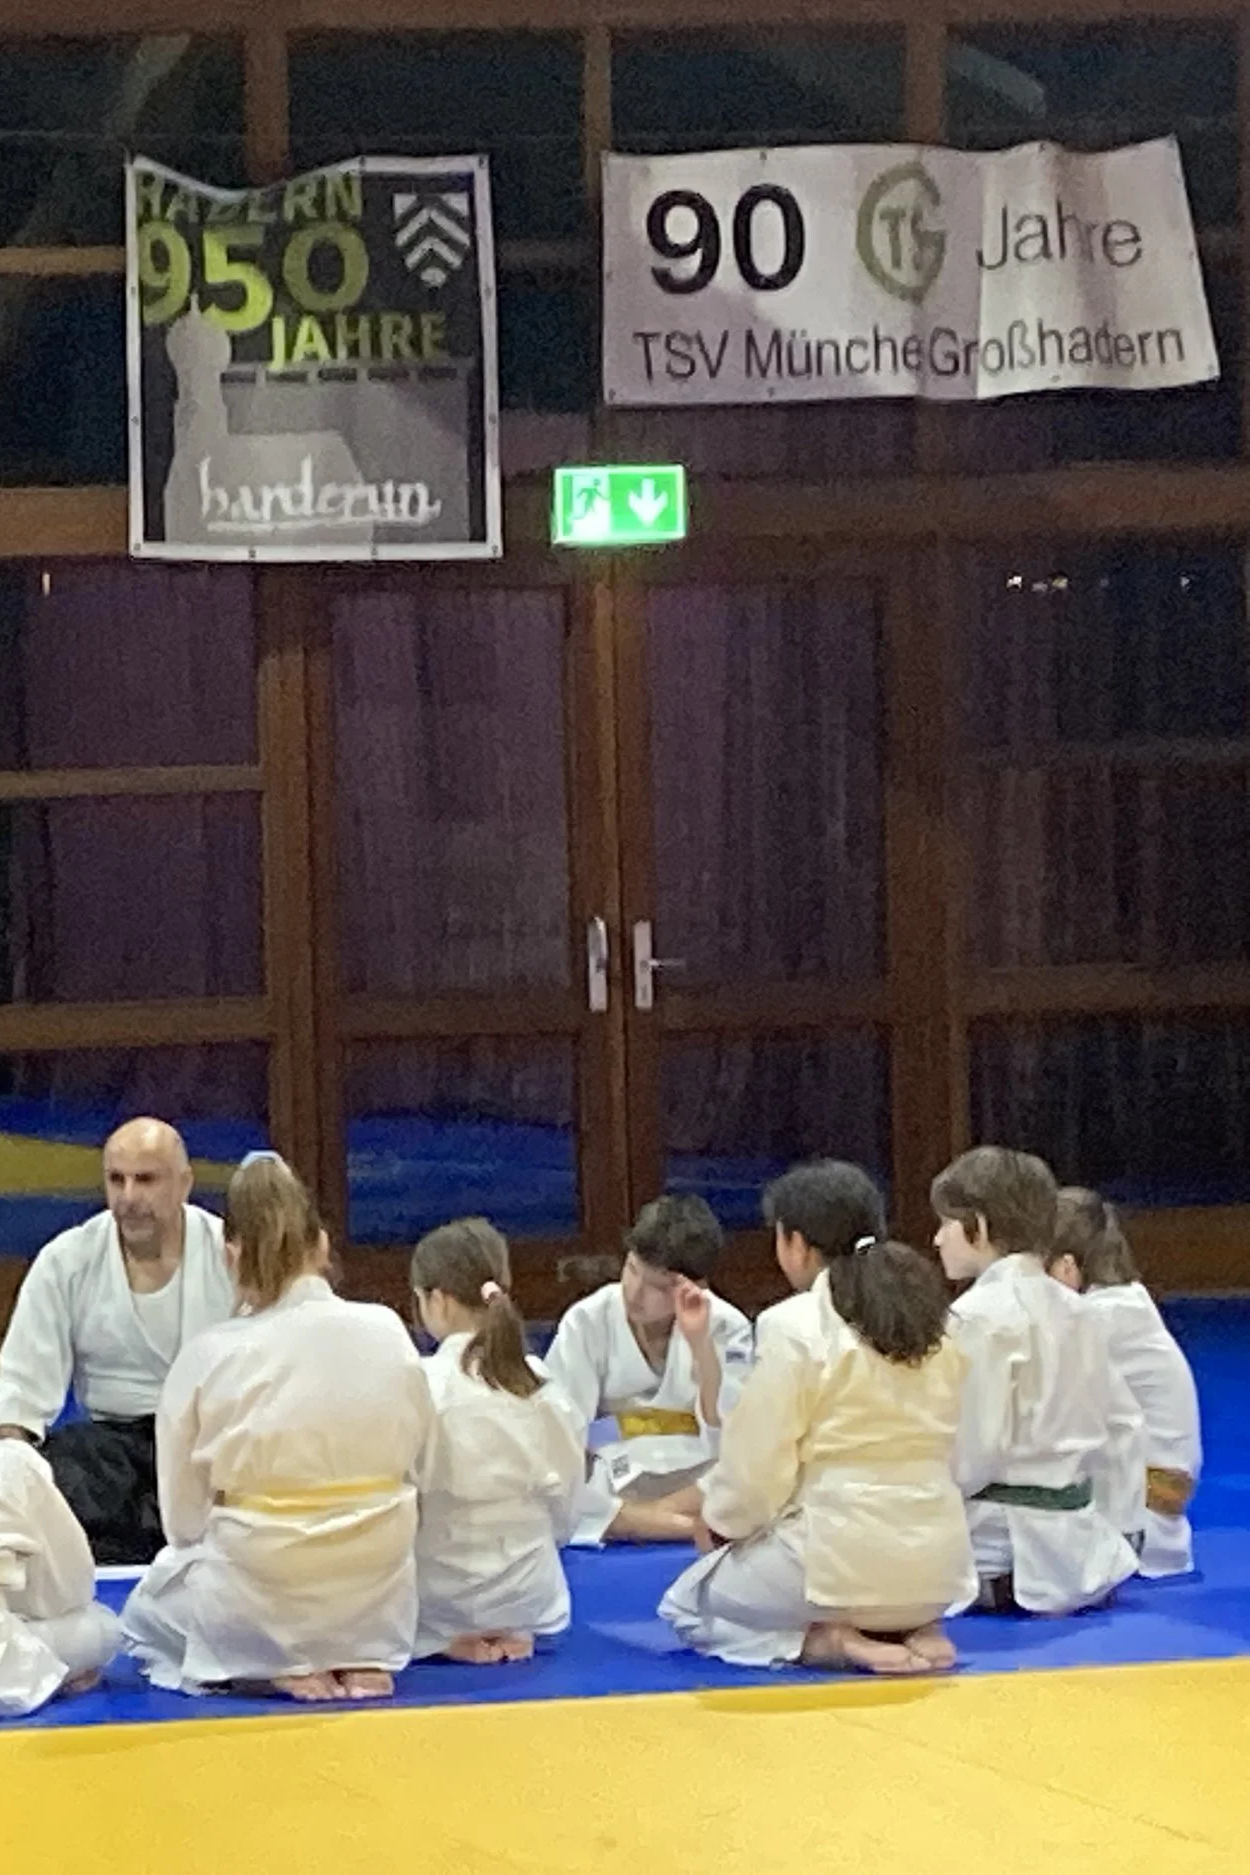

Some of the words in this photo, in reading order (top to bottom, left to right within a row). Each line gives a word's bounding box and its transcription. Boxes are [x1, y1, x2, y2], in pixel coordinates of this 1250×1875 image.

[138, 221, 370, 332] 950
[646, 182, 805, 295] 90
[975, 200, 1143, 271] Jahre
[266, 310, 447, 372] JAHRE
[633, 329, 730, 380] TSV
[744, 325, 923, 380] Münche
